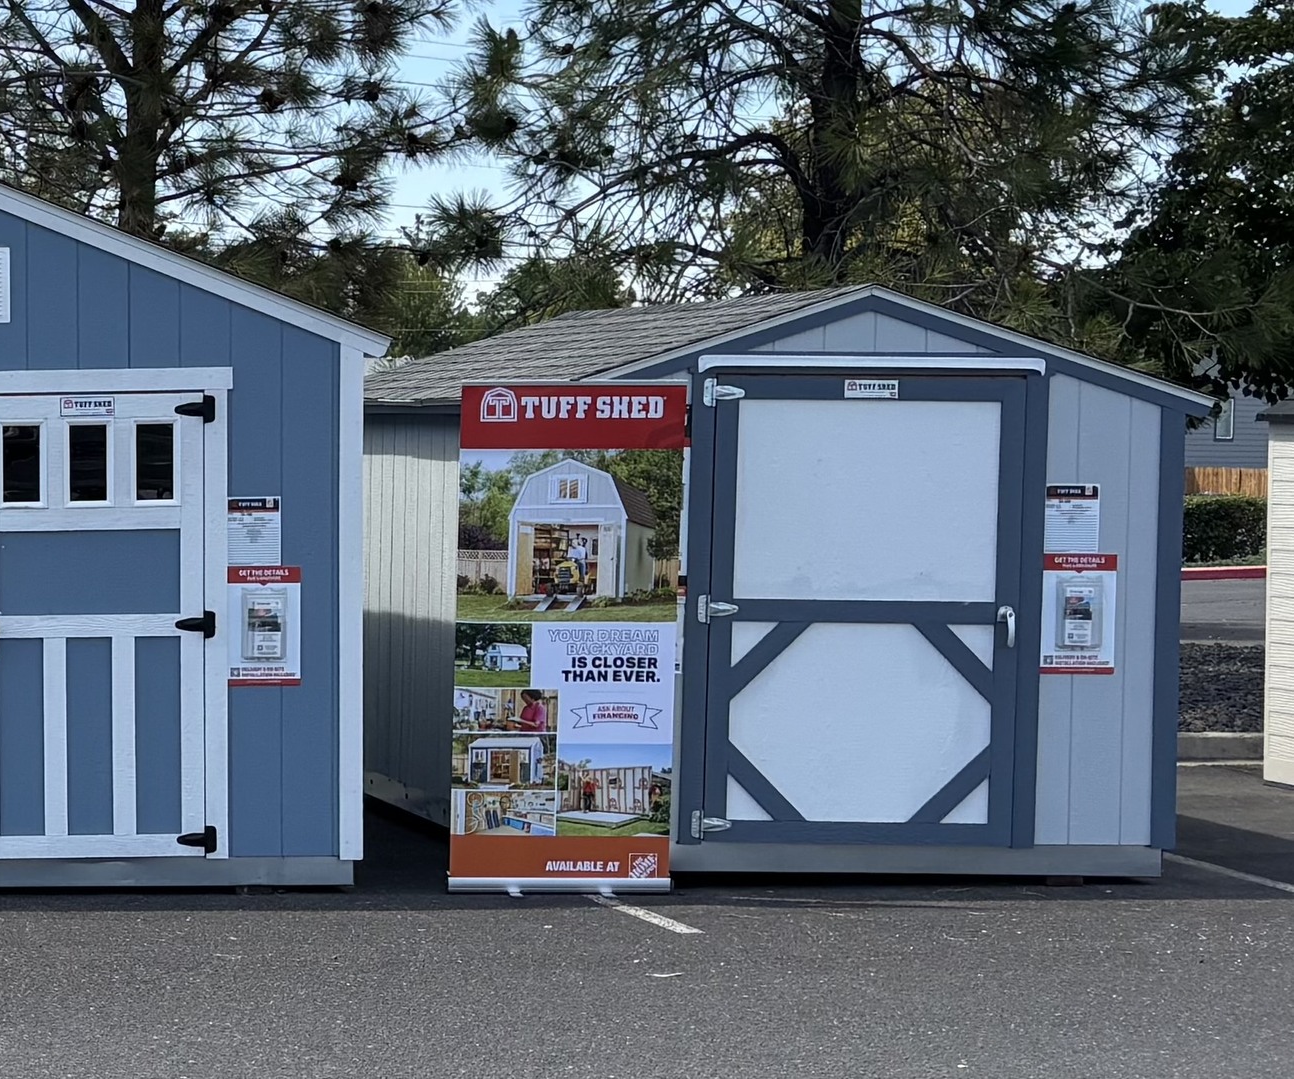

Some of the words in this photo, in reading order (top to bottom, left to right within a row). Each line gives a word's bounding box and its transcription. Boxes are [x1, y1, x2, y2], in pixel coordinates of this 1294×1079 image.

[521, 396, 592, 419] TUFF
[596, 396, 664, 419] SHED
[548, 629, 594, 642] YOUR
[597, 629, 659, 642] DREAM
[566, 643, 659, 656] BACKYARD
[572, 657, 588, 669] IS
[591, 657, 658, 669] CLOSER
[561, 670, 608, 682] THAN
[612, 670, 661, 683] EVER.
[545, 861, 604, 872] AVAILABLE
[606, 861, 620, 872] AT
